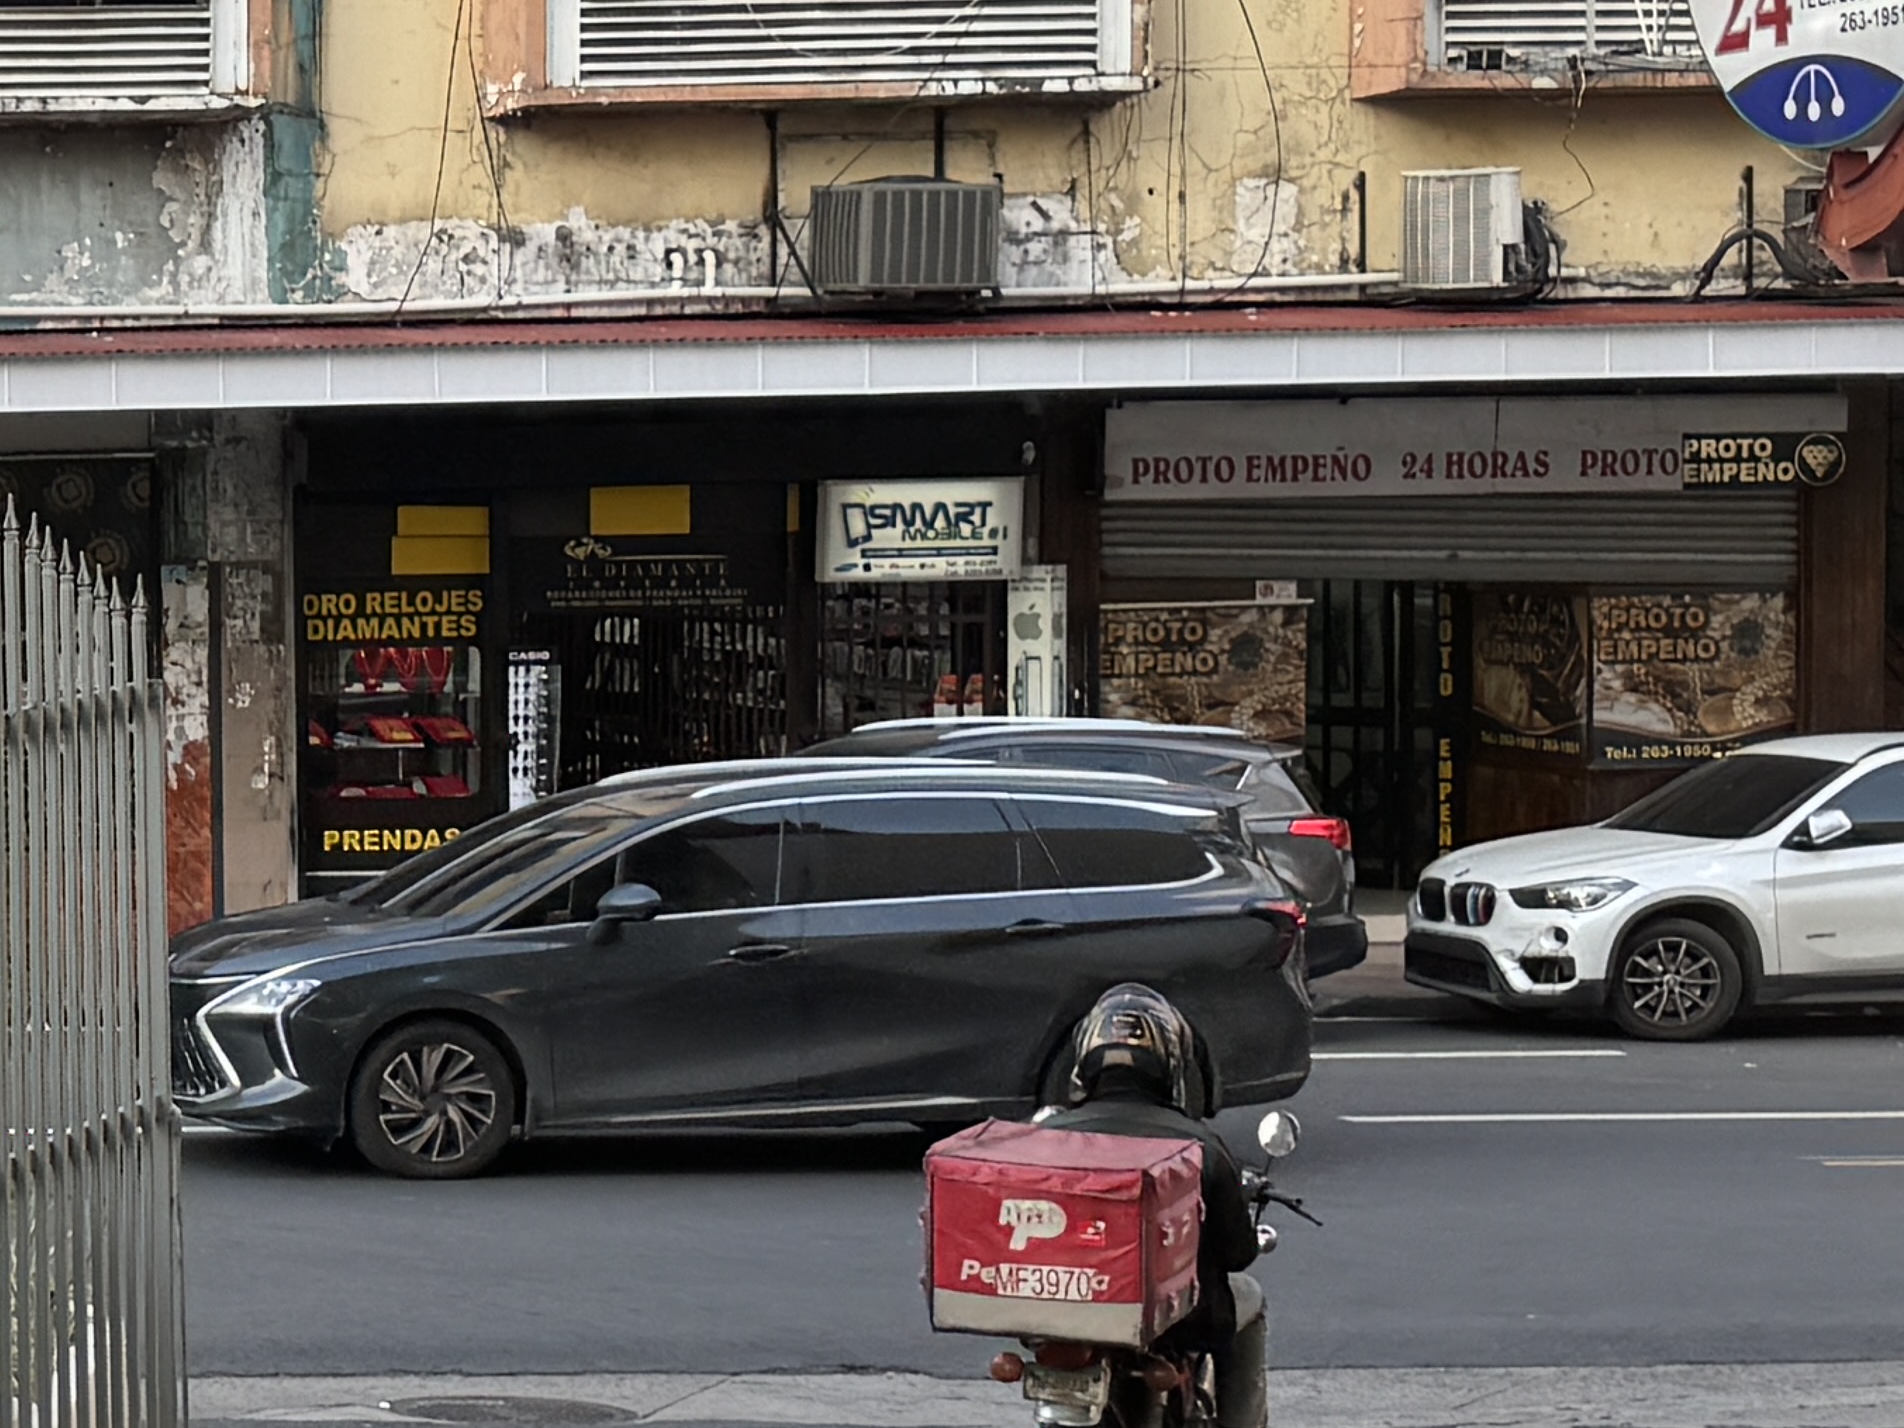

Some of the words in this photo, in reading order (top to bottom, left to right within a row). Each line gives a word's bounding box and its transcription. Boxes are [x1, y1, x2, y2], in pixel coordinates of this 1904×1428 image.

[1684, 438, 1773, 460] PROTO
[1131, 454, 1235, 485] PROTO
[1245, 445, 1372, 484] EMPEÑO
[1400, 451, 1434, 480] 24
[1444, 448, 1550, 481] HORAS
[1579, 447, 1681, 478] PROTO
[1683, 458, 1796, 484] EMPEÑO
[868, 501, 994, 530] SMART
[303, 593, 356, 616] ORO
[366, 590, 484, 614] RELOJES
[307, 615, 477, 641] DIAMANTES
[1610, 607, 1706, 630] PROTO
[1107, 621, 1204, 643] PROTO
[508, 650, 551, 661] CASIO
[995, 1266, 1092, 1299] MF3970
